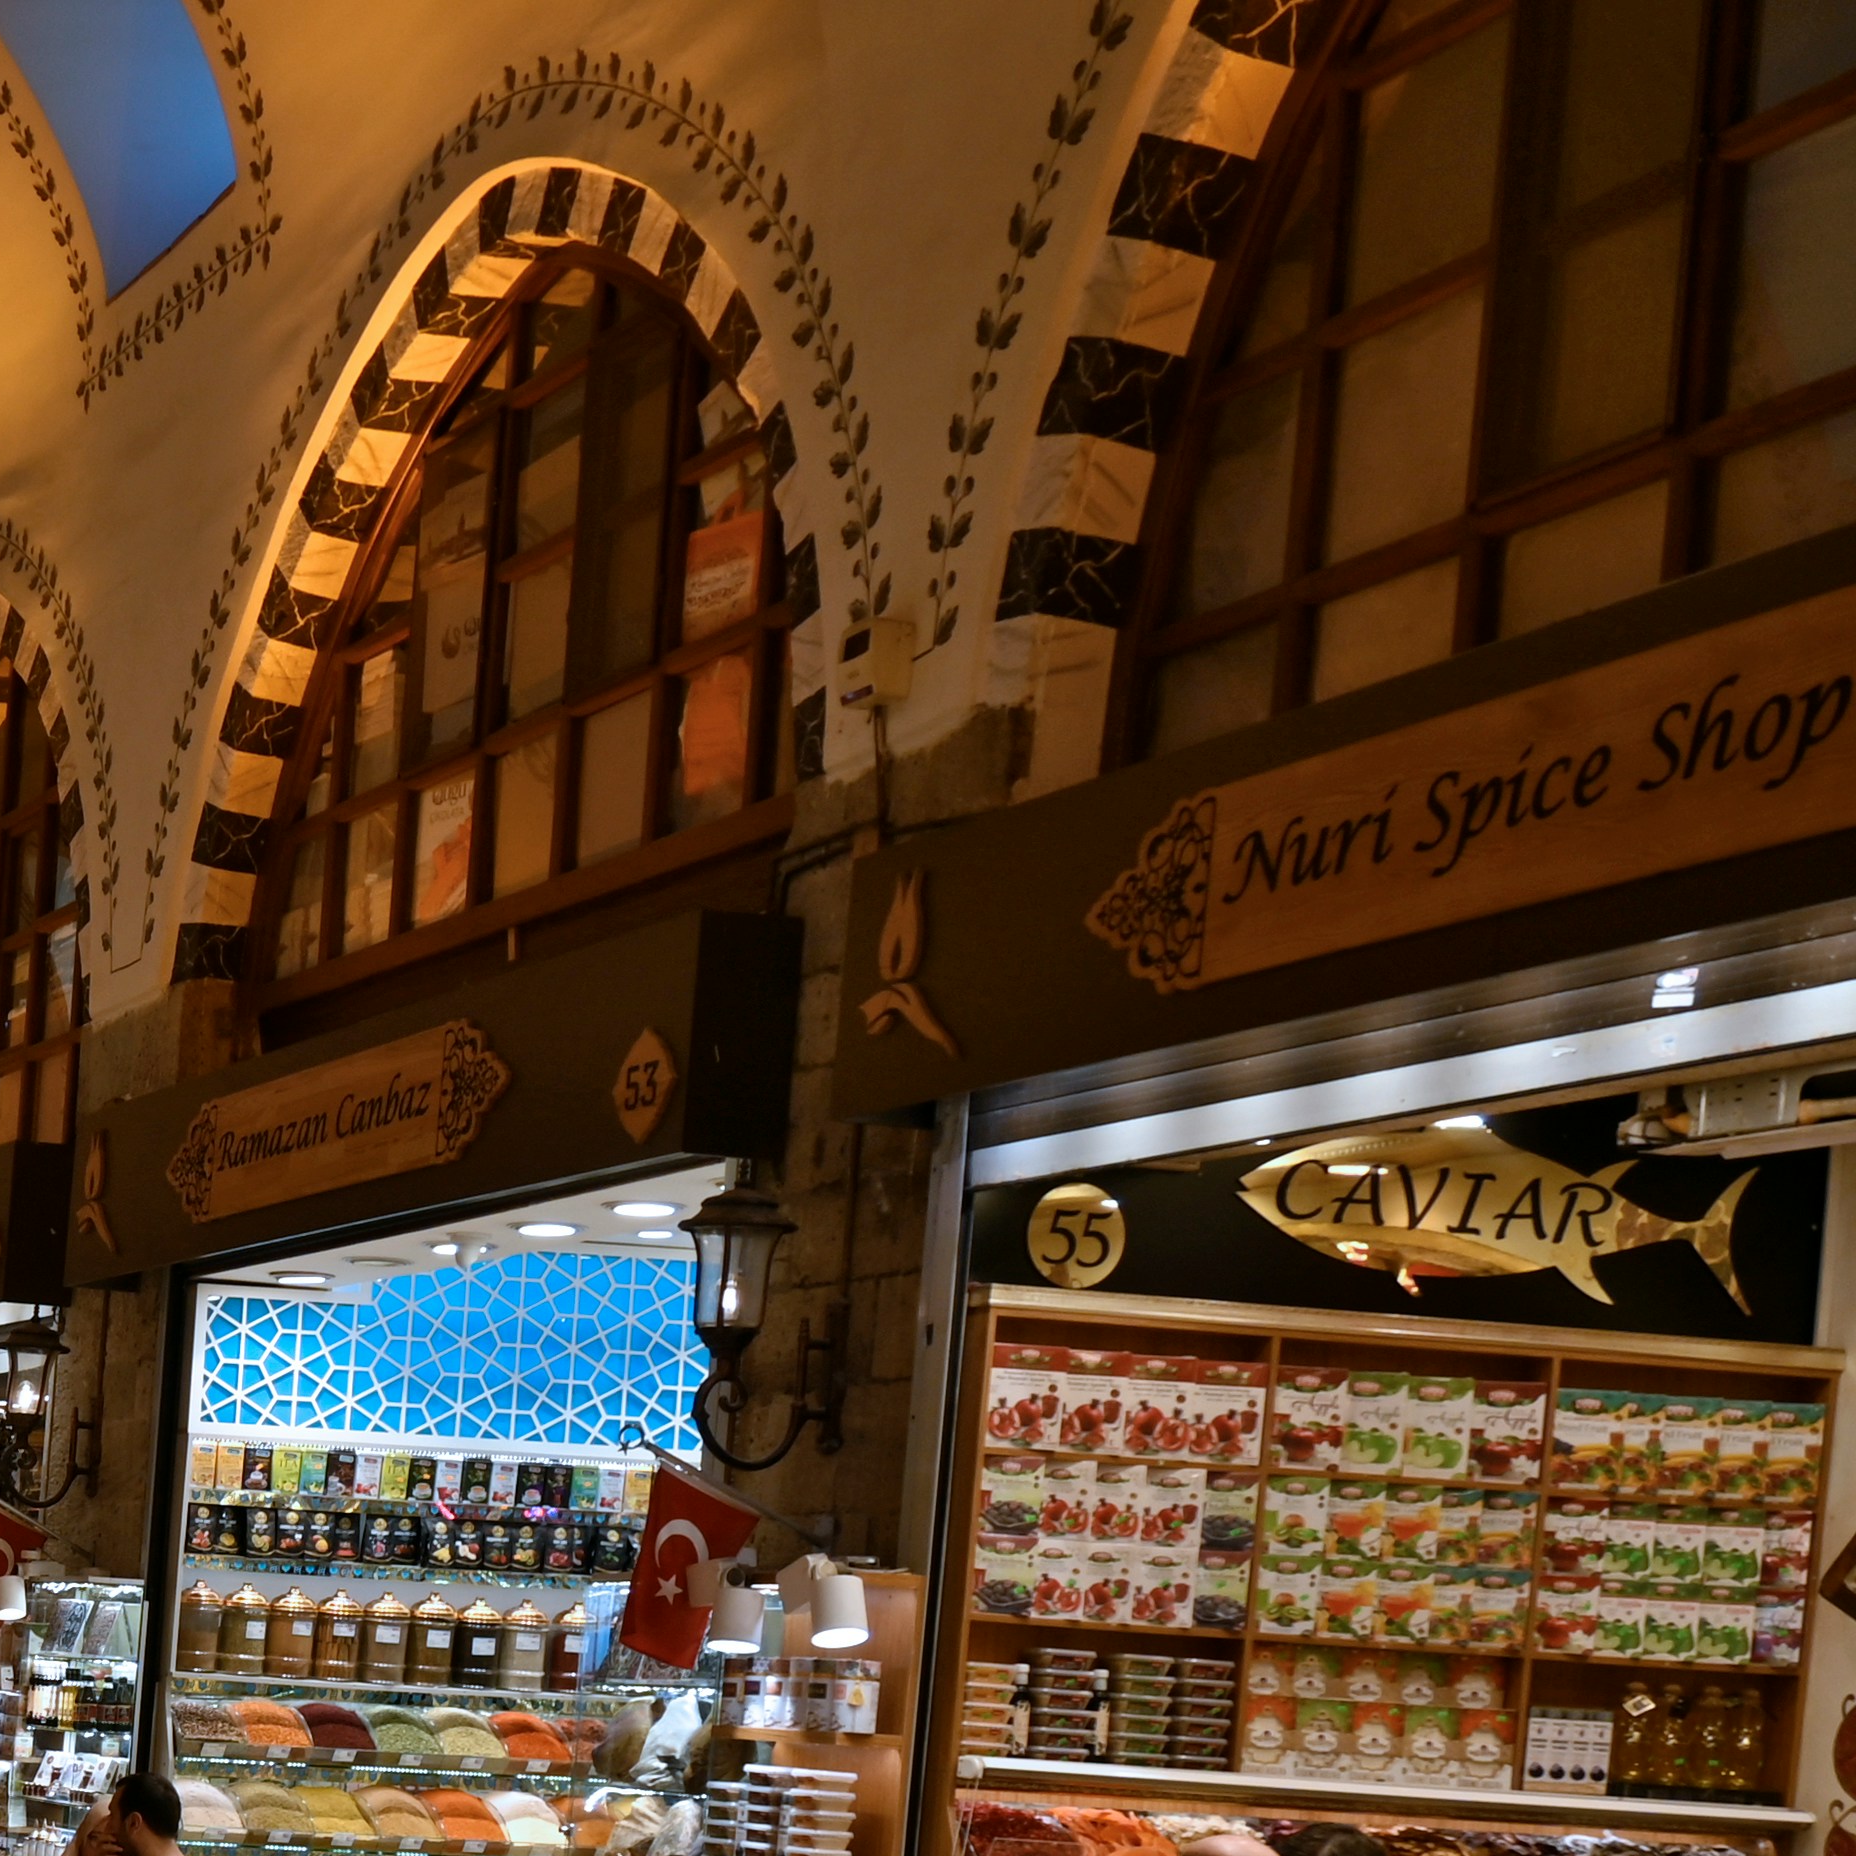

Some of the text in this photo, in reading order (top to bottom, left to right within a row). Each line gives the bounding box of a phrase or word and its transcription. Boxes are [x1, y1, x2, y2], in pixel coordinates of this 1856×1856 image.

[1222, 673, 1854, 904] Nuri Spice Shop
[217, 1072, 434, 1172] Ramazan Canbaz
[624, 1060, 660, 1111] 53
[1040, 1208, 1111, 1268] 55
[1275, 1159, 1614, 1248] CAVIAR
